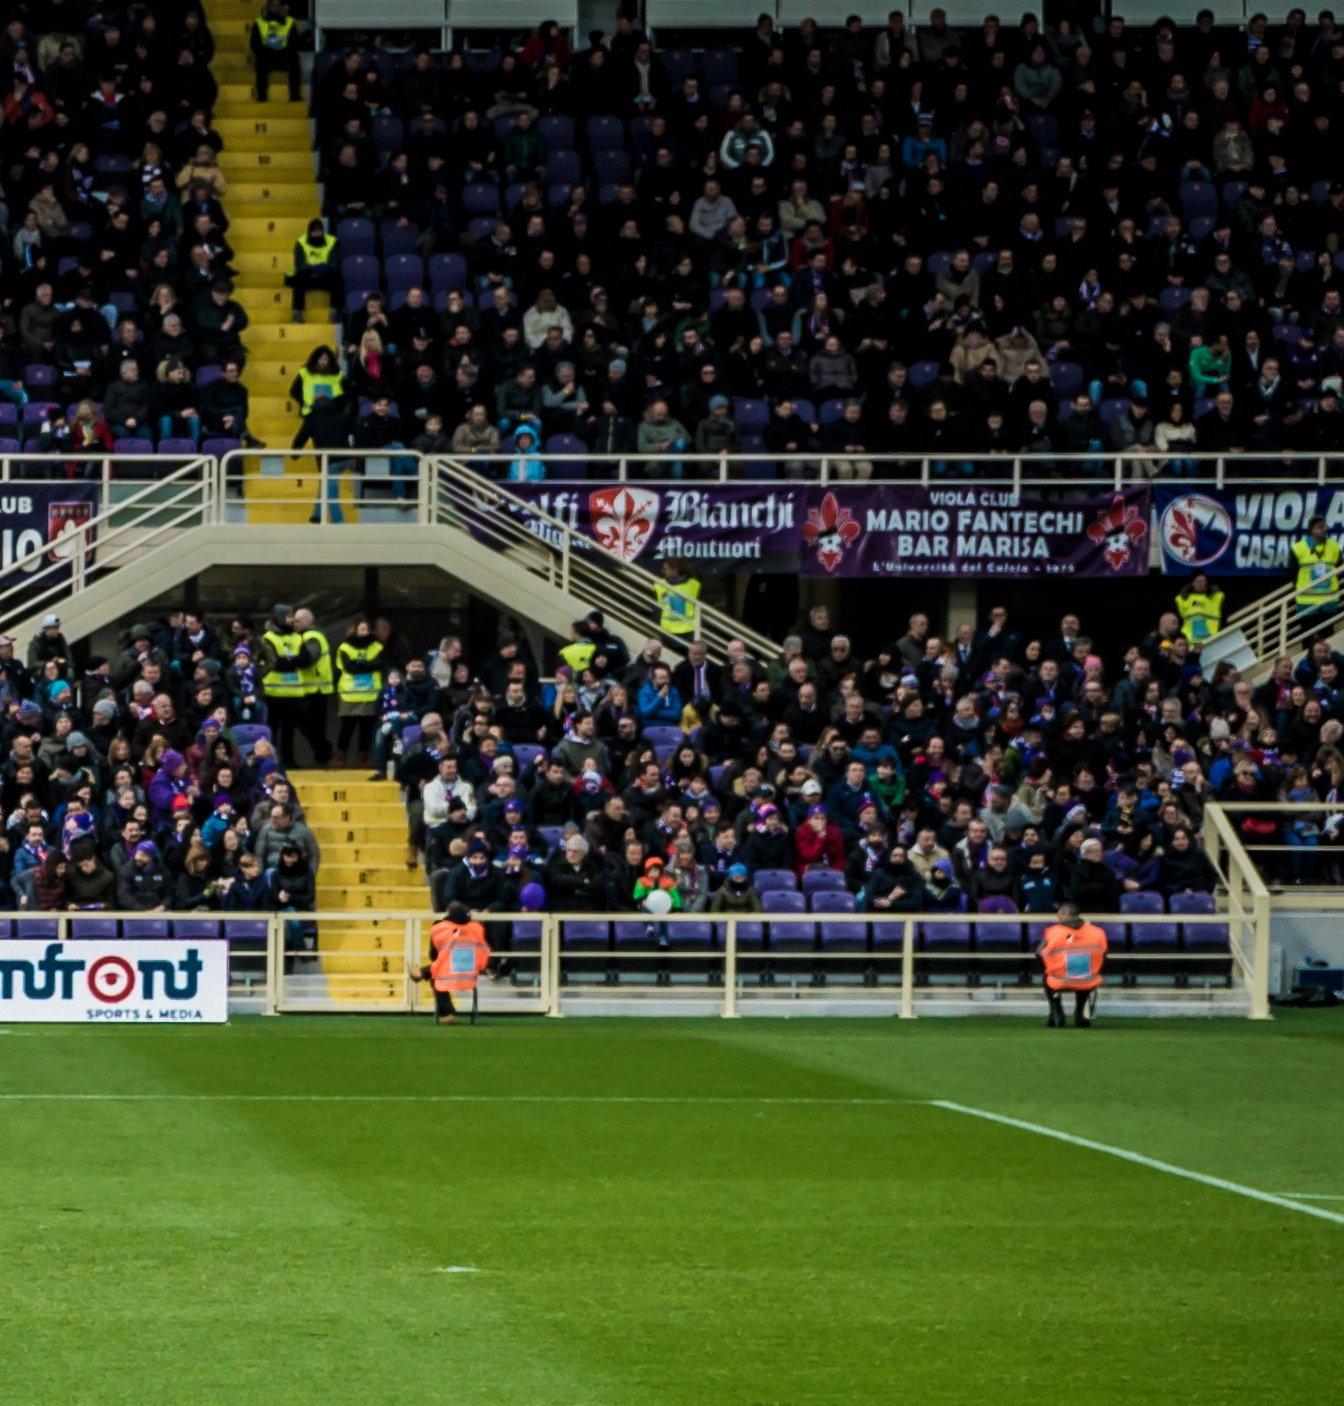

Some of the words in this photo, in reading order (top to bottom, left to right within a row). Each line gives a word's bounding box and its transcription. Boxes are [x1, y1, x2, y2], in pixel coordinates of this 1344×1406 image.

[929, 491, 974, 506] VIOLA
[664, 489, 795, 534] Bianchi
[866, 509, 950, 532] MARIO
[957, 510, 1084, 534] FANTECHI
[652, 535, 761, 560] Montuori
[897, 535, 949, 557] BAR
[956, 535, 1050, 559] MARISA
[86, 1008, 140, 1019] SPORTS
[144, 1008, 154, 1019] &
[158, 1008, 204, 1019] MEDIA
